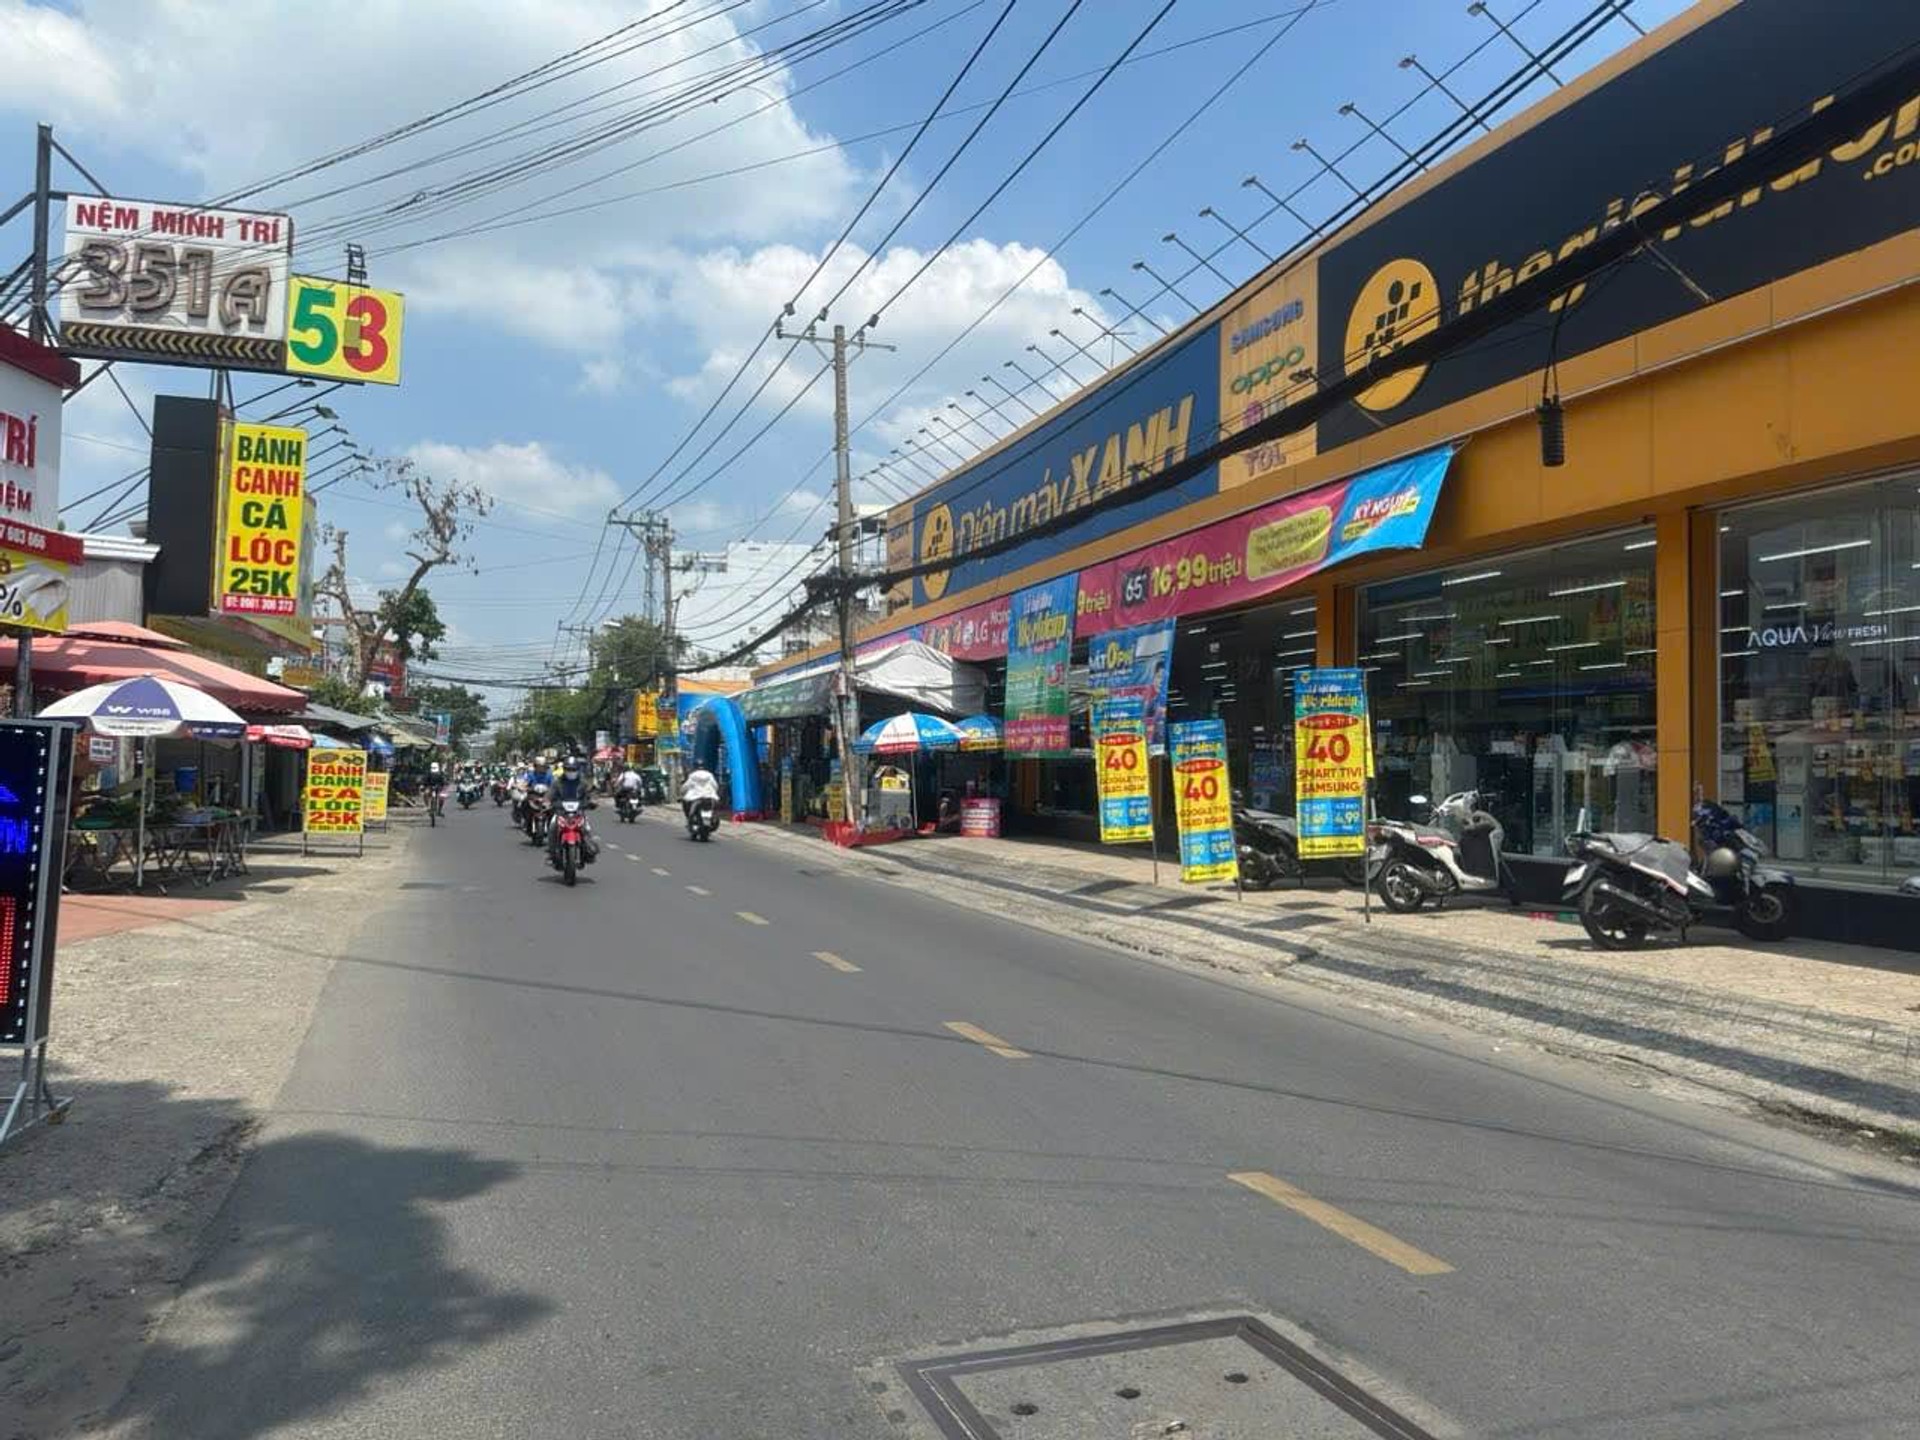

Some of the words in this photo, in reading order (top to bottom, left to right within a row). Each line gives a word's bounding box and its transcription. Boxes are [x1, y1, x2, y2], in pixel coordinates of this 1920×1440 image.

[76, 202, 139, 232] NỆM
[152, 210, 224, 239] MINH
[238, 217, 280, 244] TRÍ
[289, 288, 389, 372] 53
[238, 432, 302, 467] BÁNH
[235, 467, 300, 498] CANH
[242, 498, 288, 530] CÁ
[231, 533, 296, 566] LÓC
[230, 569, 291, 597] 25K
[1152, 554, 1207, 598] 16,99
[1209, 552, 1242, 586] triệu
[1848, 624, 1888, 639] FRESH
[1105, 748, 1138, 771] 40
[1307, 734, 1351, 763] 40
[311, 776, 362, 787] CANH
[1184, 776, 1219, 802] 40
[1301, 781, 1361, 794] SAMSUNG
[309, 812, 359, 825] 25K
